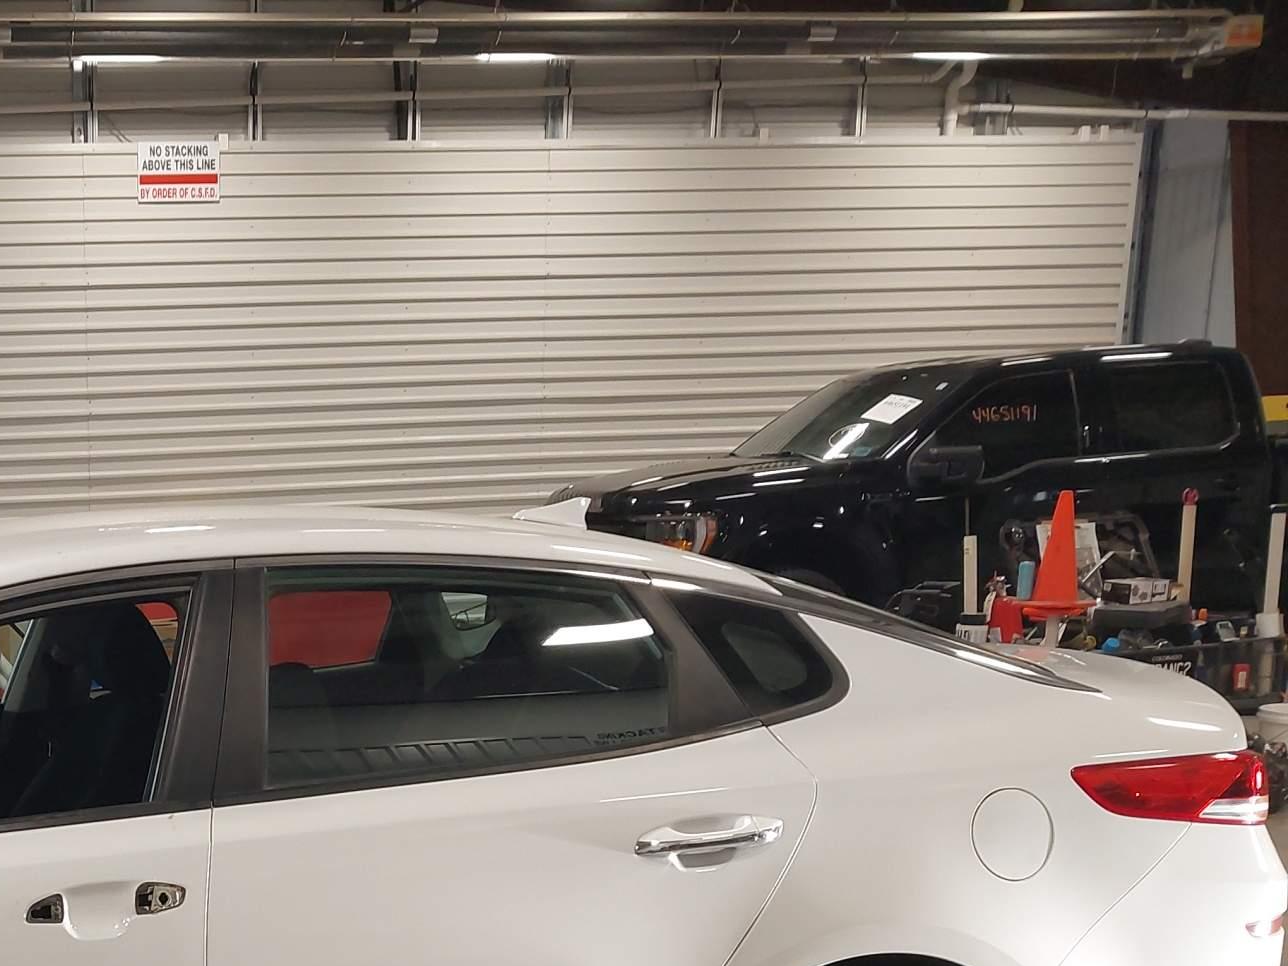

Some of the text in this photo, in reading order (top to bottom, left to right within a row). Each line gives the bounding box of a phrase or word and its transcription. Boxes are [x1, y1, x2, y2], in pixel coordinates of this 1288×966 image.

[149, 145, 209, 157] NO STACKING
[142, 158, 216, 171] ABOVE THIS LINE
[140, 188, 151, 199] BY
[152, 188, 177, 199] ORDER
[179, 187, 189, 198] OF
[972, 404, 1038, 424] 44651191
